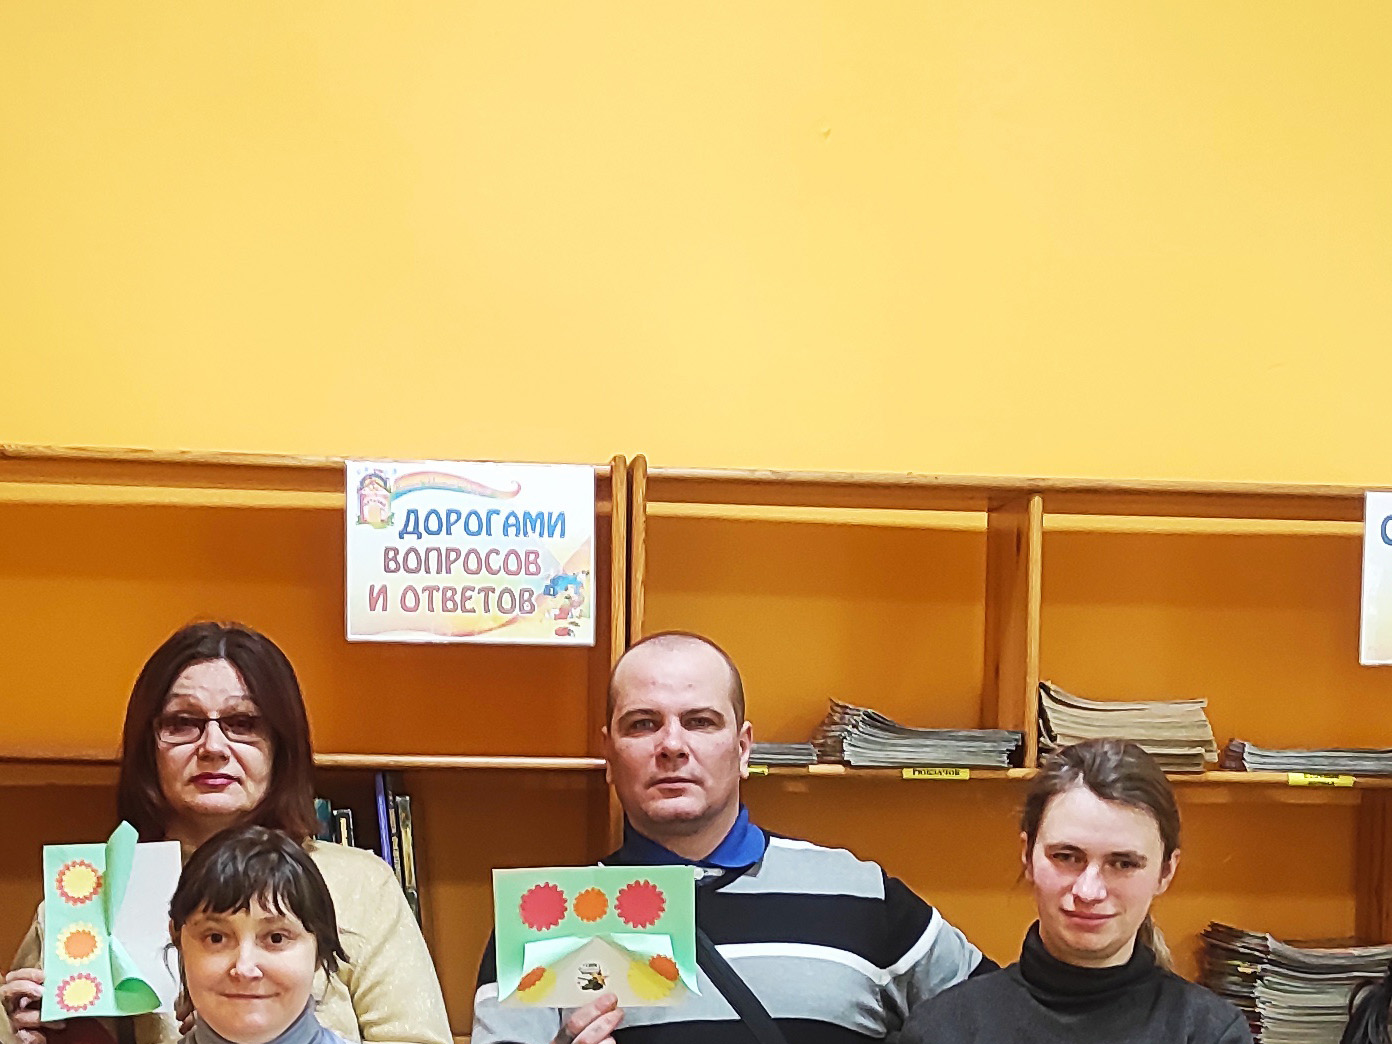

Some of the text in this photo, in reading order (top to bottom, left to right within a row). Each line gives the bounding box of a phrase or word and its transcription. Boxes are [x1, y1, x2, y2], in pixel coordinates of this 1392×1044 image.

[398, 508, 566, 540] ДОРОГАМИ
[384, 546, 541, 576] ВОПРОСОВ
[369, 584, 536, 615] И ОТВЕТОВ
